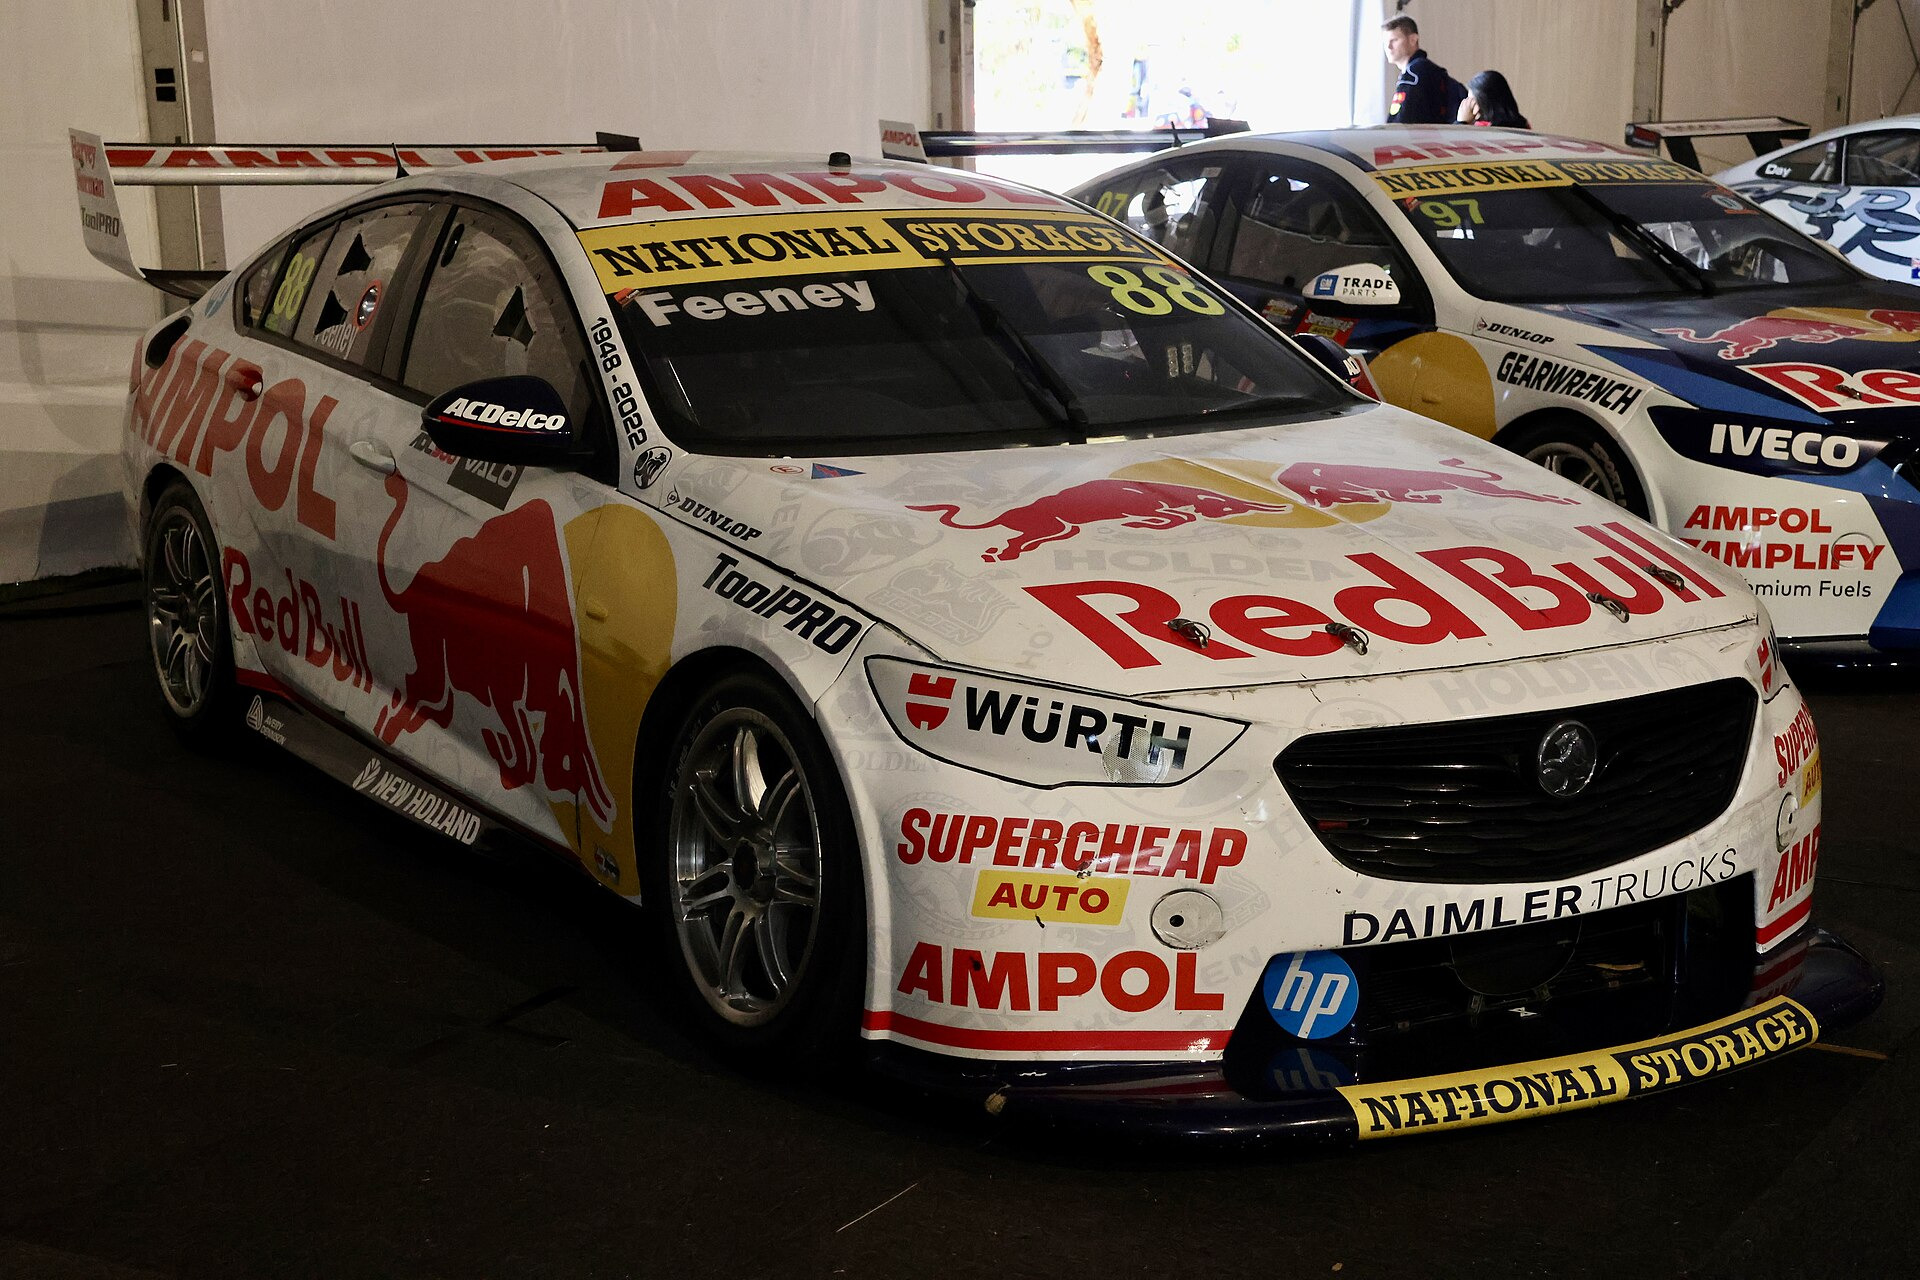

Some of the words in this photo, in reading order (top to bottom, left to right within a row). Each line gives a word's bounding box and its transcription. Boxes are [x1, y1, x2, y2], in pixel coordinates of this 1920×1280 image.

[882, 129, 919, 147] AMPOL
[1375, 164, 1559, 194] NATIONAL
[1560, 161, 1703, 184] STORAGE
[1765, 164, 1792, 179] Day
[597, 171, 1063, 218] AMPOL
[1420, 198, 1486, 228] 97
[80, 206, 121, 237] ToolPRO
[593, 225, 901, 277] NATIONAL
[904, 221, 1147, 256] STORAGE
[273, 252, 316, 321] 88
[639, 281, 877, 327] Feeney
[1087, 265, 1227, 316] 88
[1342, 288, 1378, 298] PARTS
[1343, 277, 1394, 290] TRADE
[315, 322, 359, 360] eeney
[1487, 322, 1555, 345] DUNLOP
[1496, 350, 1643, 415] GEARWRENCH
[443, 397, 566, 431] ACDelco
[130, 333, 340, 541] AMPOL
[1709, 423, 1860, 468] IVECO
[678, 497, 763, 542] DUNLOP
[1683, 505, 1833, 534] AMPOL
[1053, 549, 1353, 584] HOLDEN
[1697, 538, 1886, 571] AMPLIFY
[702, 552, 863, 655] ToolPRO
[1818, 580, 1872, 598] Fuels
[1429, 645, 1657, 716] HOLDEN
[370, 770, 410, 807] NEW
[404, 784, 482, 846] HOLLAND
[897, 807, 1249, 885] SUPERCHEAP
[987, 882, 1110, 913] AUTO
[1343, 884, 1584, 947] DAIMLER
[1591, 846, 1737, 910] TRUCKS
[897, 941, 1225, 1013] AMPOL
[1273, 953, 1350, 1039] hp
[1363, 1065, 1617, 1131] NATIONAL
[1630, 1006, 1807, 1092] STORAGE
